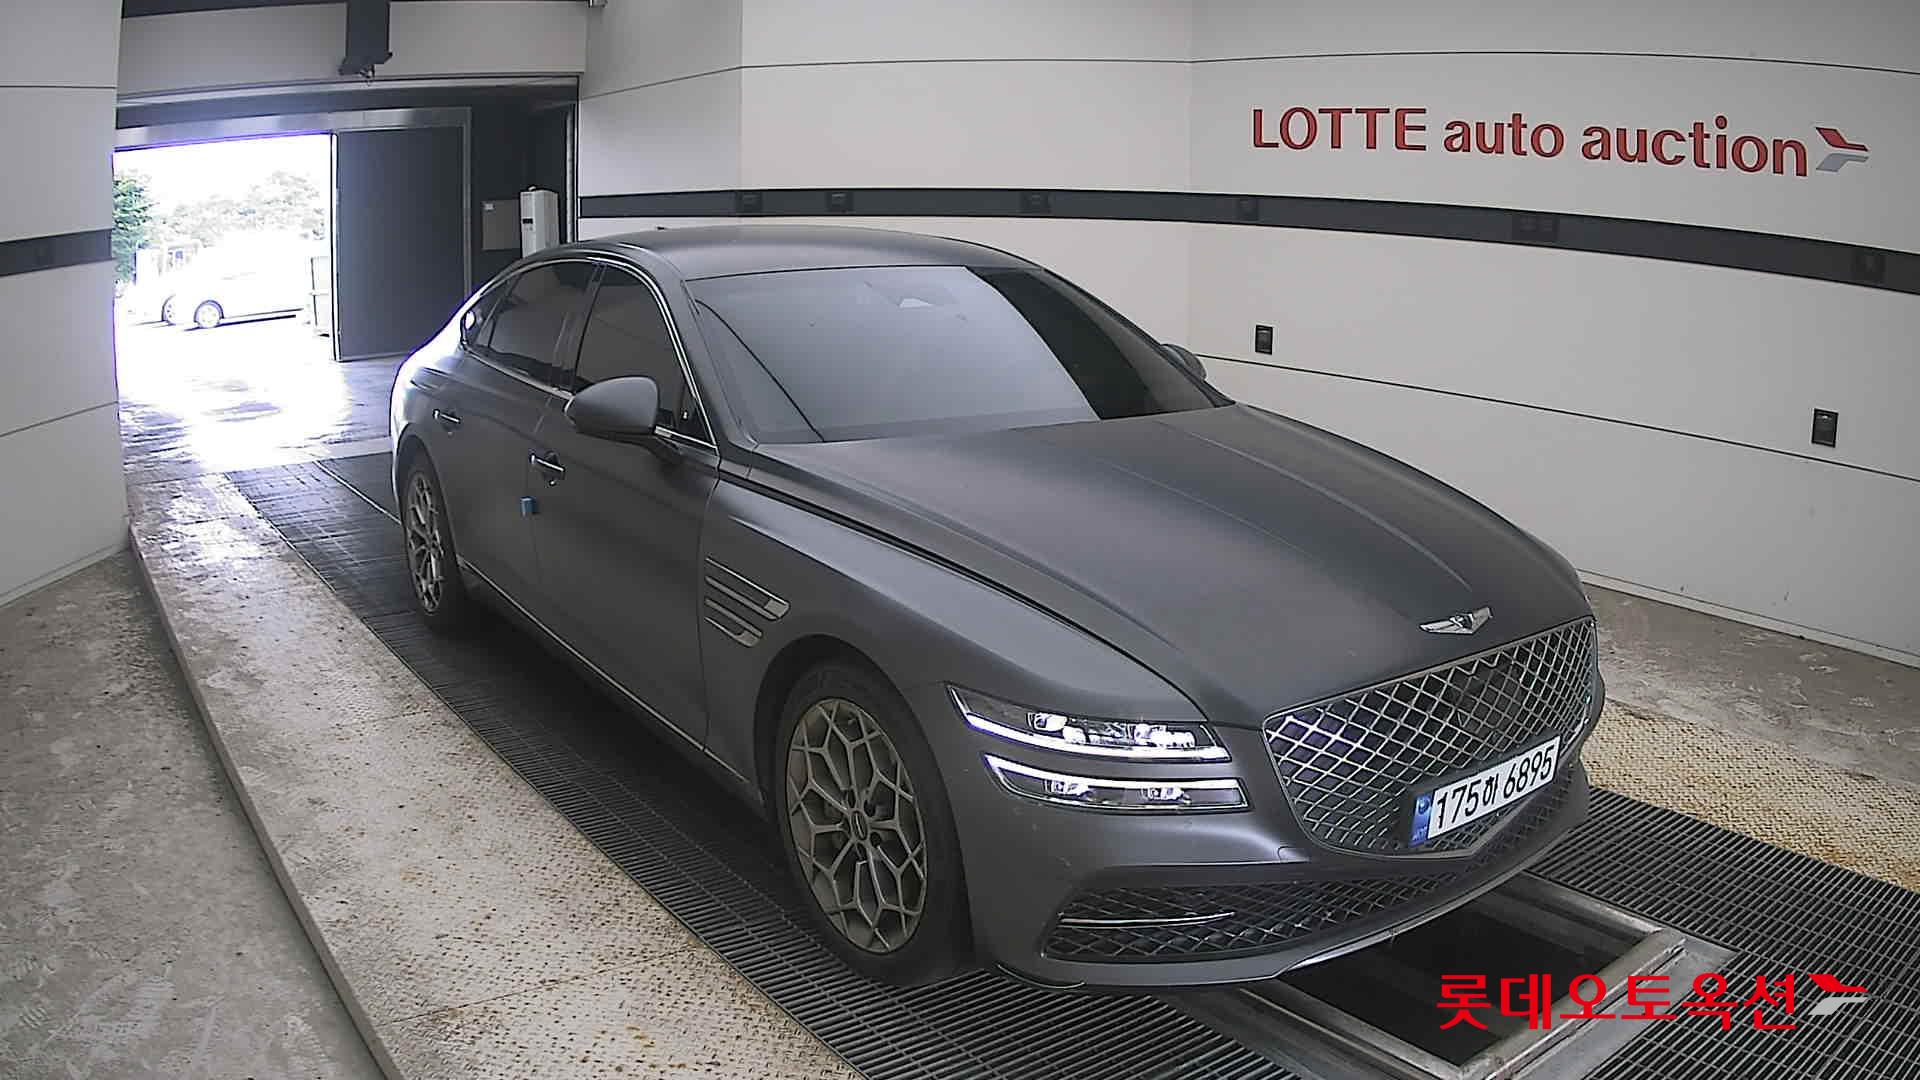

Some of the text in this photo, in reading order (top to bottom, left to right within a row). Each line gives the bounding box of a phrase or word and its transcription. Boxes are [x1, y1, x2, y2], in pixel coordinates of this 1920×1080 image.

[1253, 107, 1808, 177] LOTTE auto auction
[1503, 744, 1556, 799] 6895
